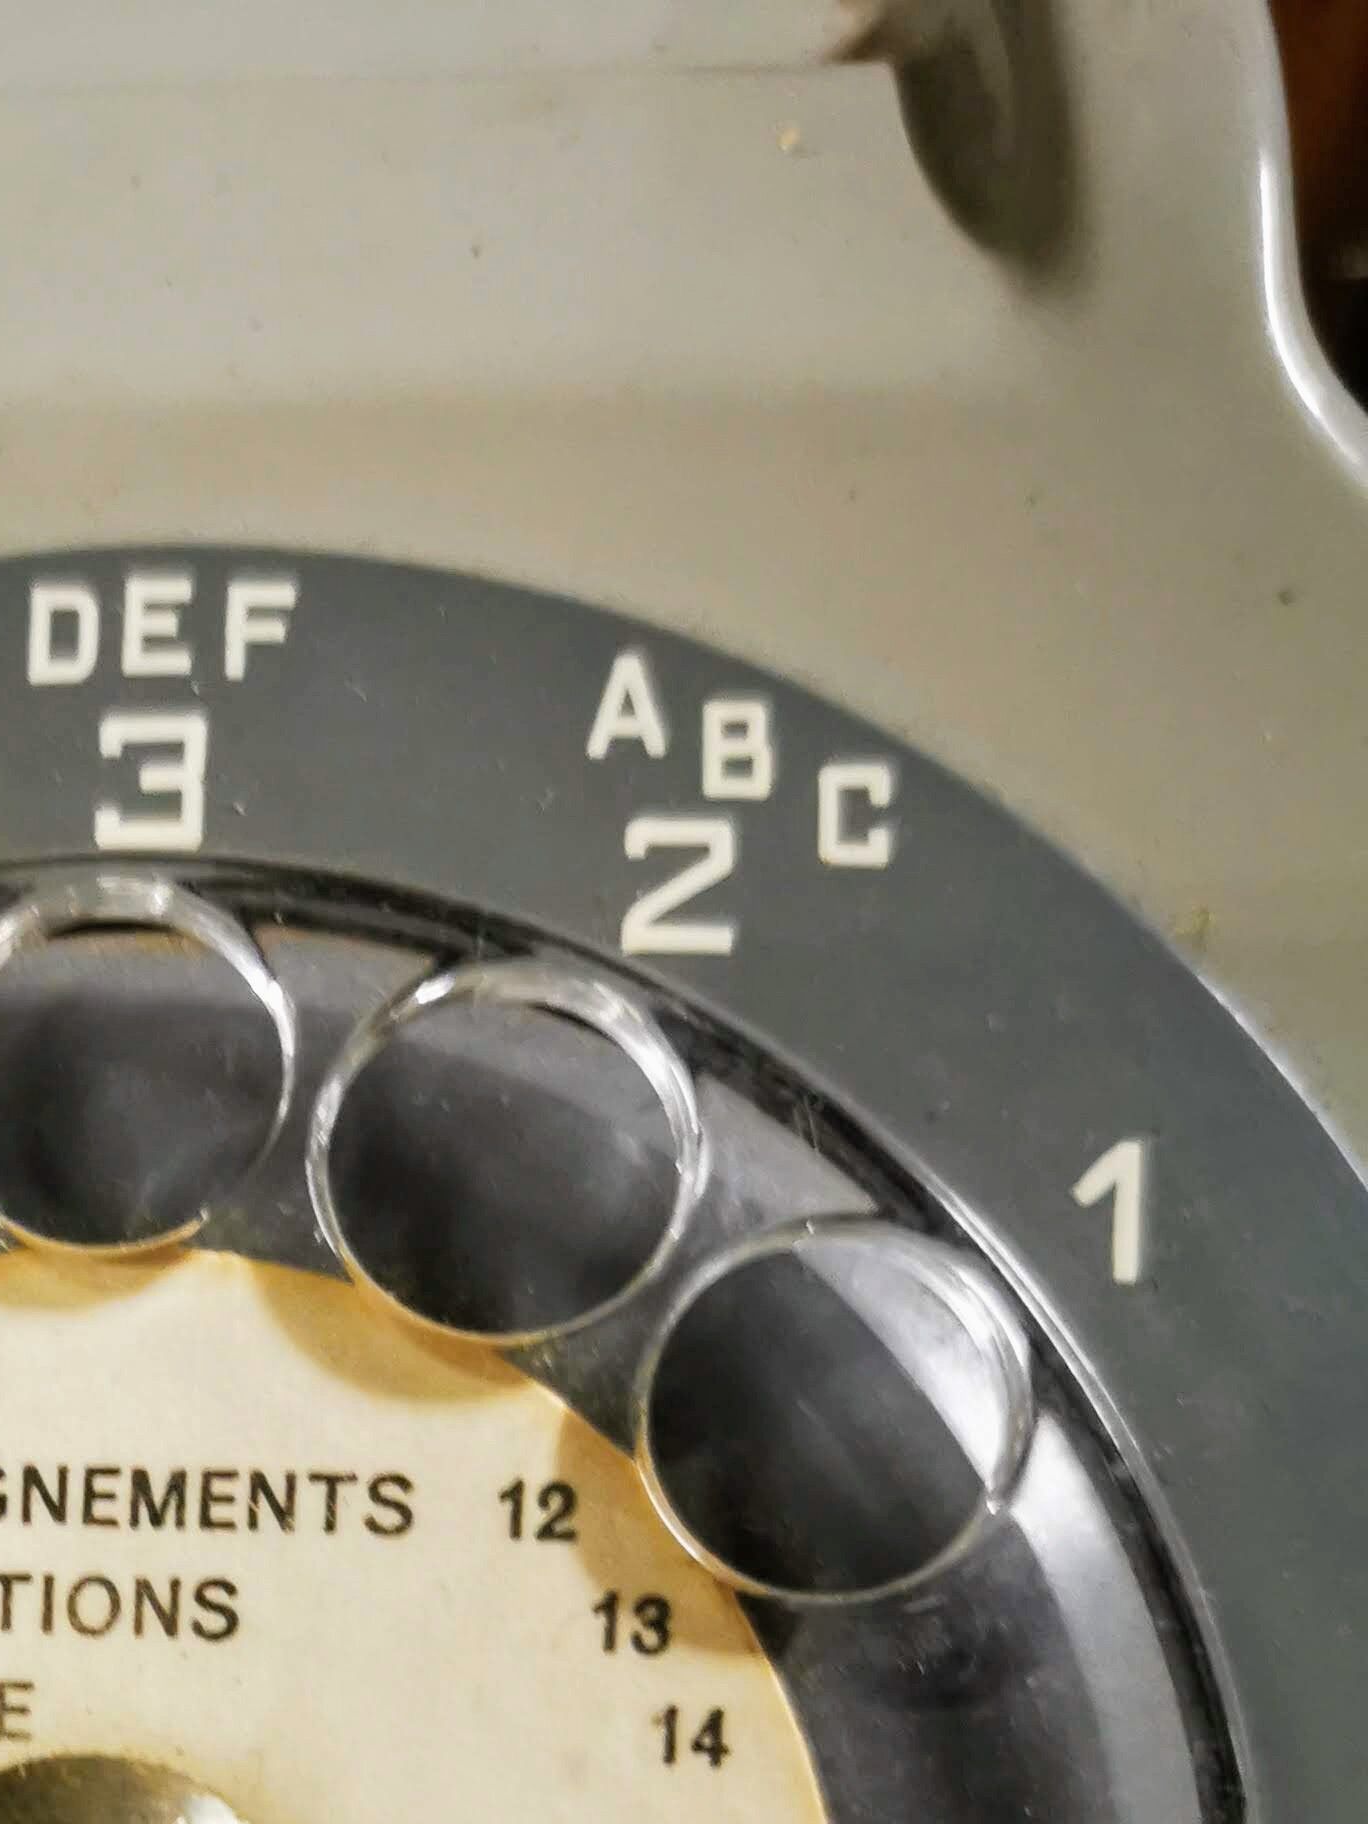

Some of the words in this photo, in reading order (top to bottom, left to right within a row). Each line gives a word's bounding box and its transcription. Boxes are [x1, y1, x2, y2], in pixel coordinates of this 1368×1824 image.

[94, 710, 208, 851] 3
[621, 814, 736, 957] 2
[1071, 1138, 1145, 1285] 1
[500, 1475, 578, 1543] 12
[592, 1591, 673, 1656] 13
[654, 1703, 730, 1767] 14
